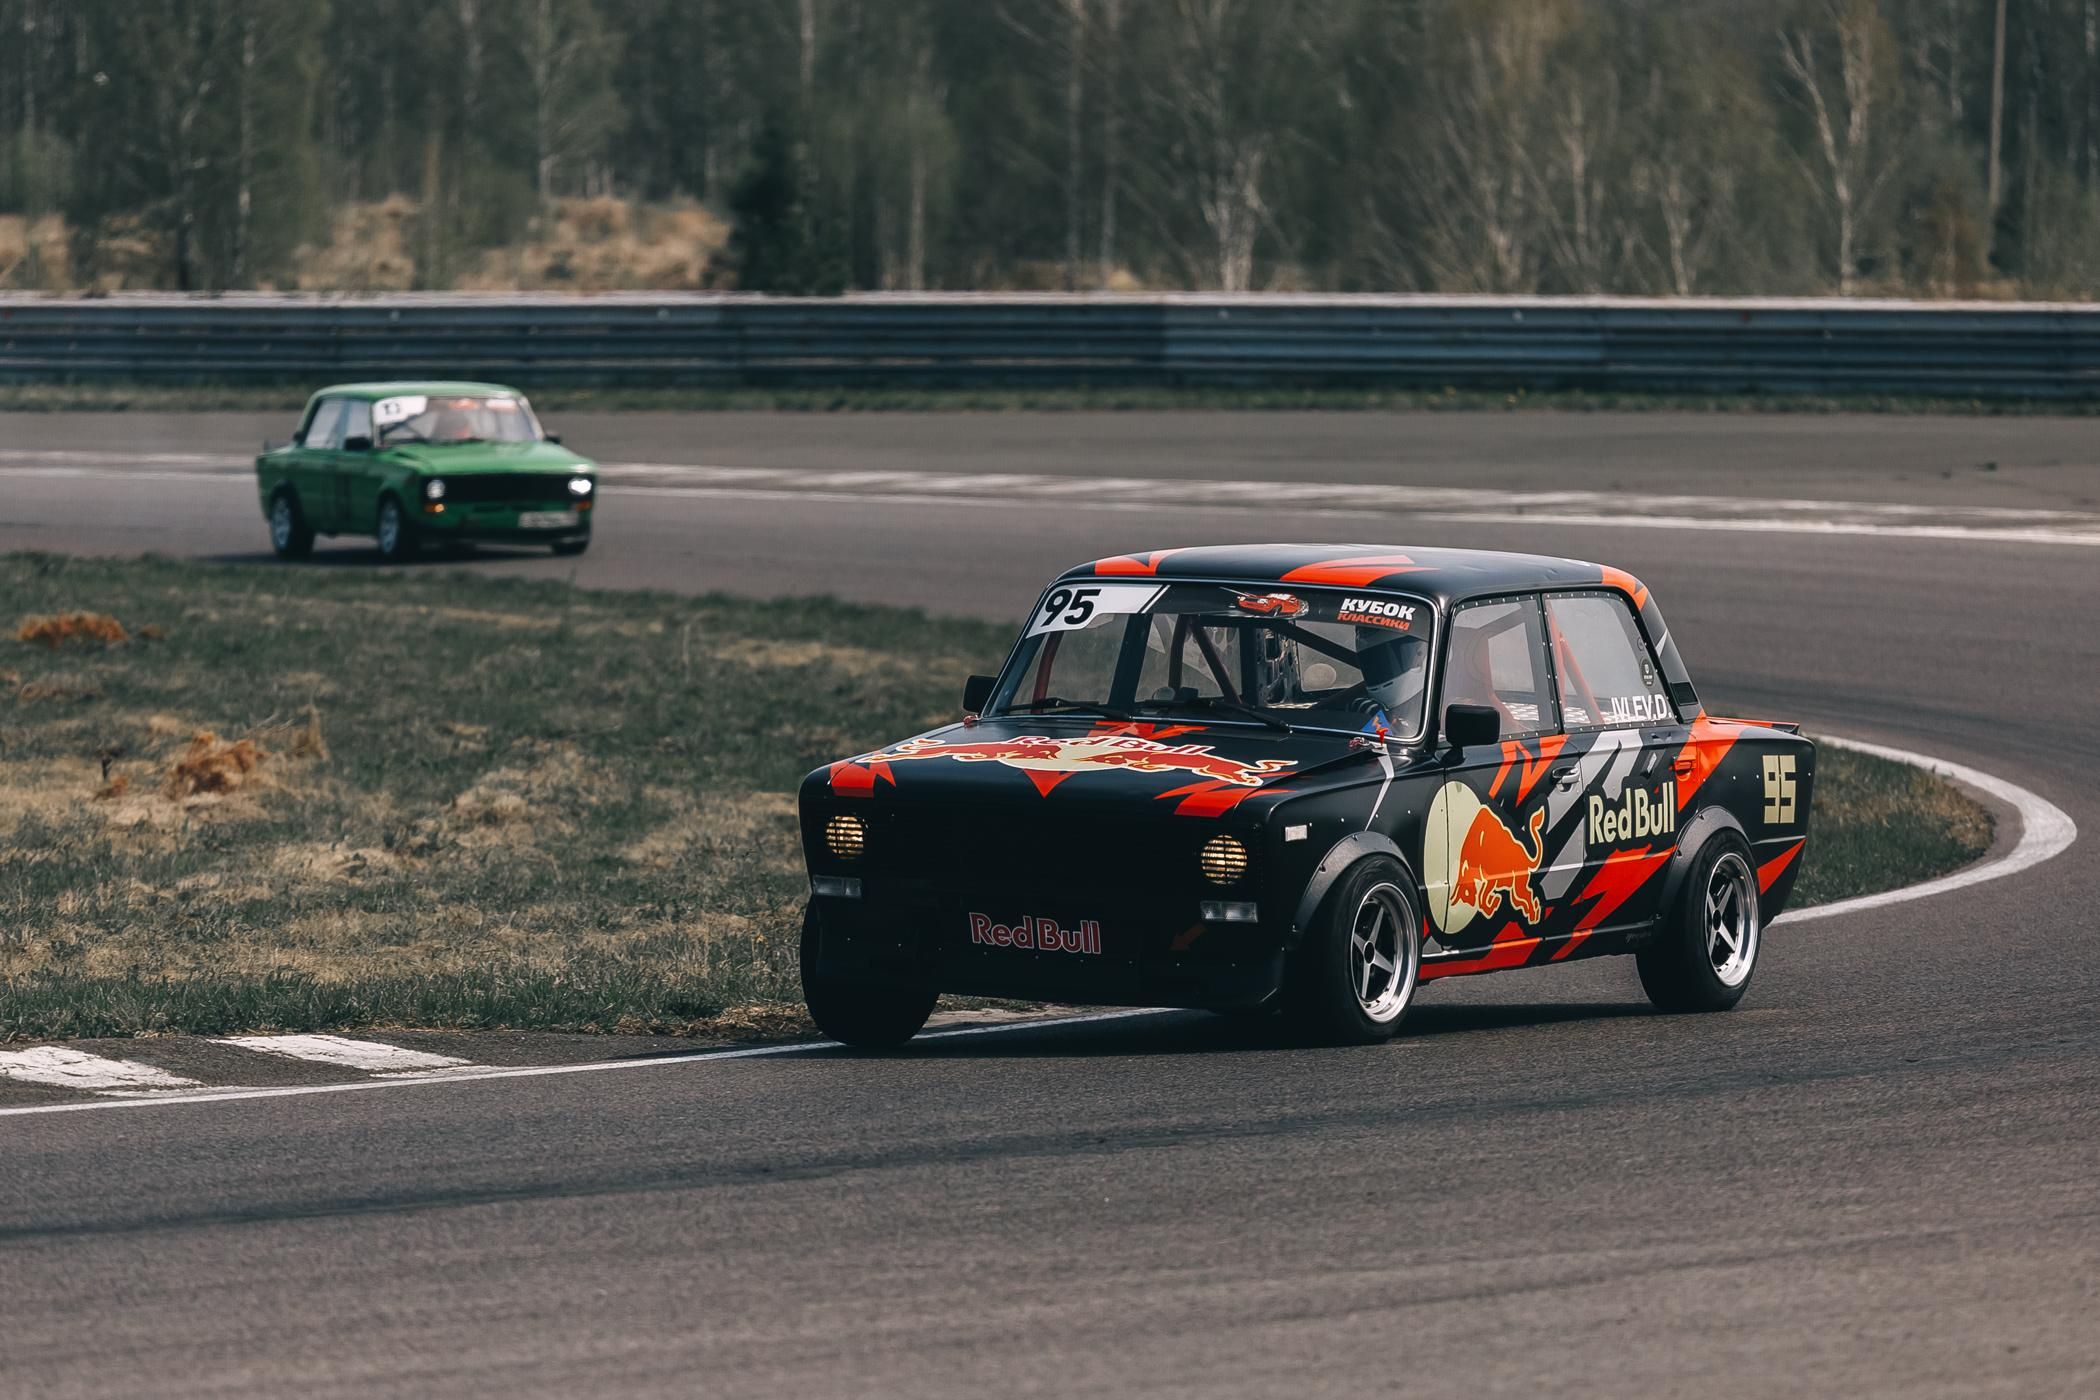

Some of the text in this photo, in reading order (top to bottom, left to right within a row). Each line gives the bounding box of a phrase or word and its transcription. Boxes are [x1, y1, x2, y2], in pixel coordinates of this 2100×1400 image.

[1040, 588, 1101, 627] 95
[1337, 612, 1410, 631] КЛАССИКИ
[1341, 598, 1416, 620] КУБОК
[1011, 735, 1215, 755] Red Bull
[1762, 755, 1797, 824] 95
[1589, 781, 1675, 845] Red Bull
[968, 911, 1102, 955] Red Bull
